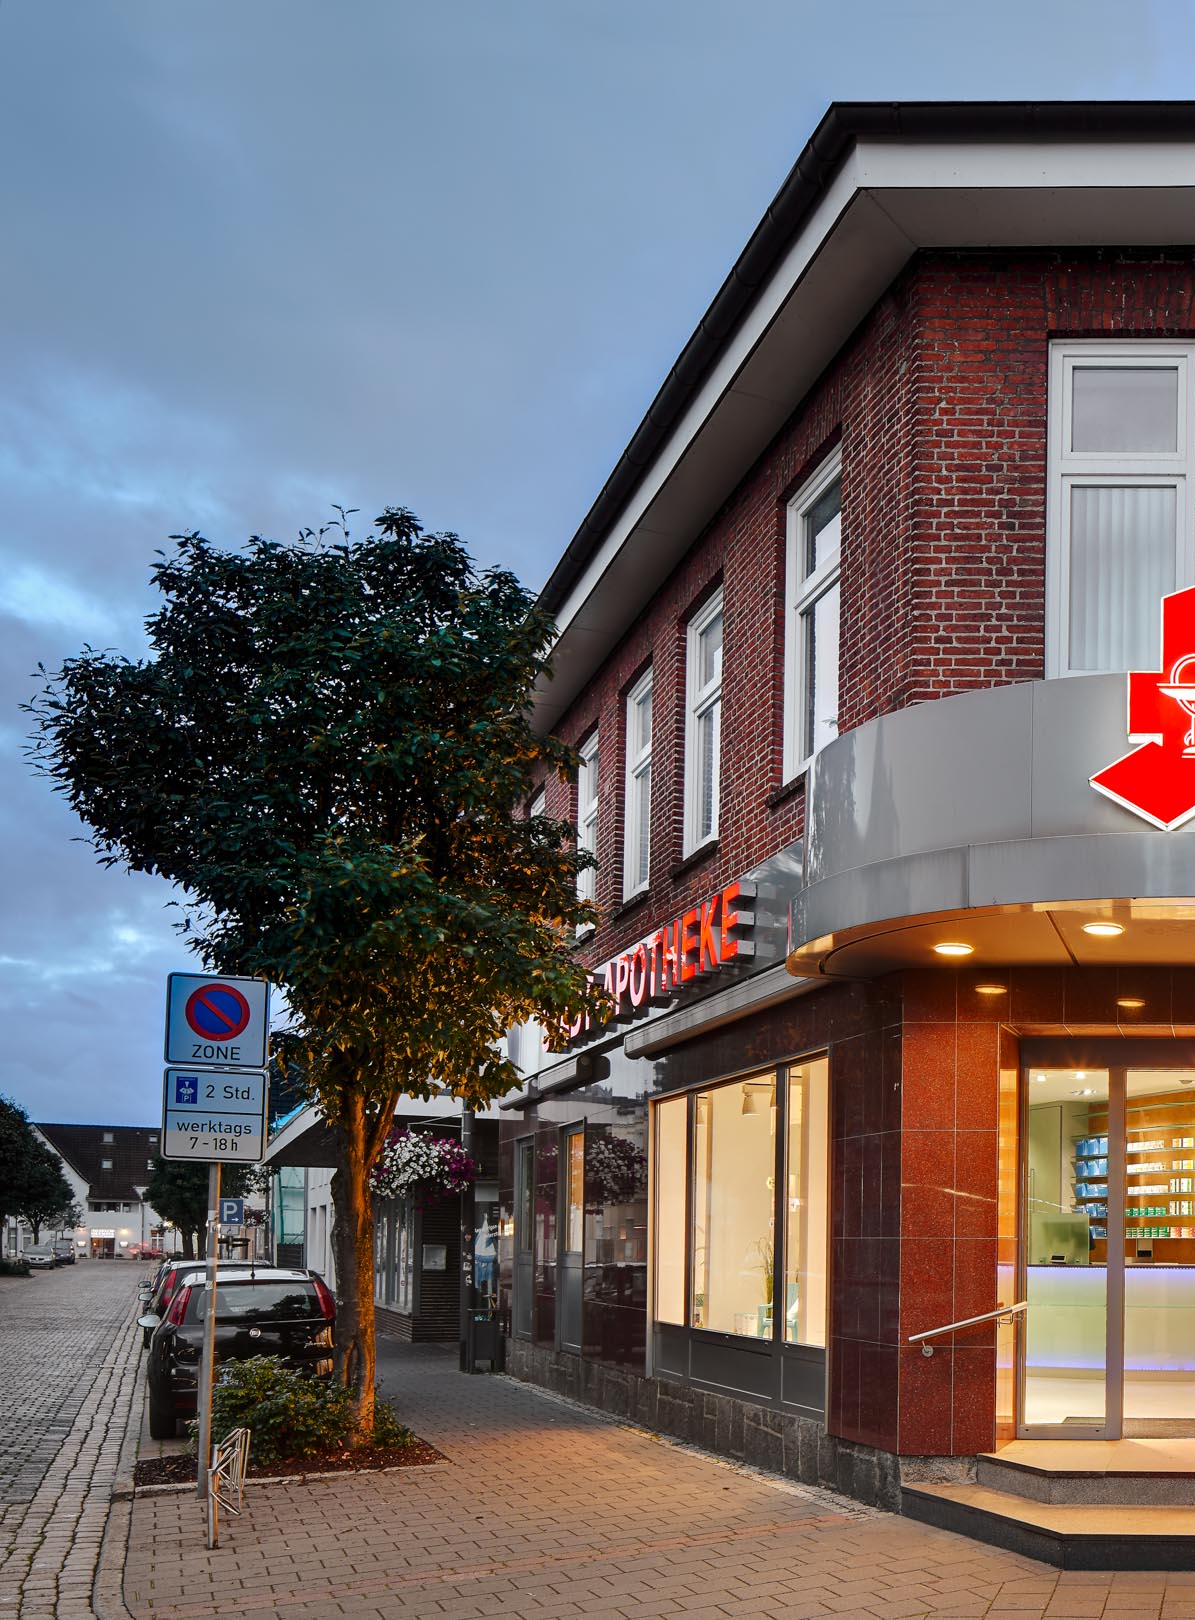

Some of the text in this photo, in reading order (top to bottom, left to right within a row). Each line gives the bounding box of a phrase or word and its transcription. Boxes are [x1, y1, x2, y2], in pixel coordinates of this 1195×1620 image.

[191, 1044, 241, 1061] ZONE
[205, 1084, 255, 1100] 2 Std.
[176, 1120, 252, 1137] werktags
[223, 1201, 238, 1222] P
